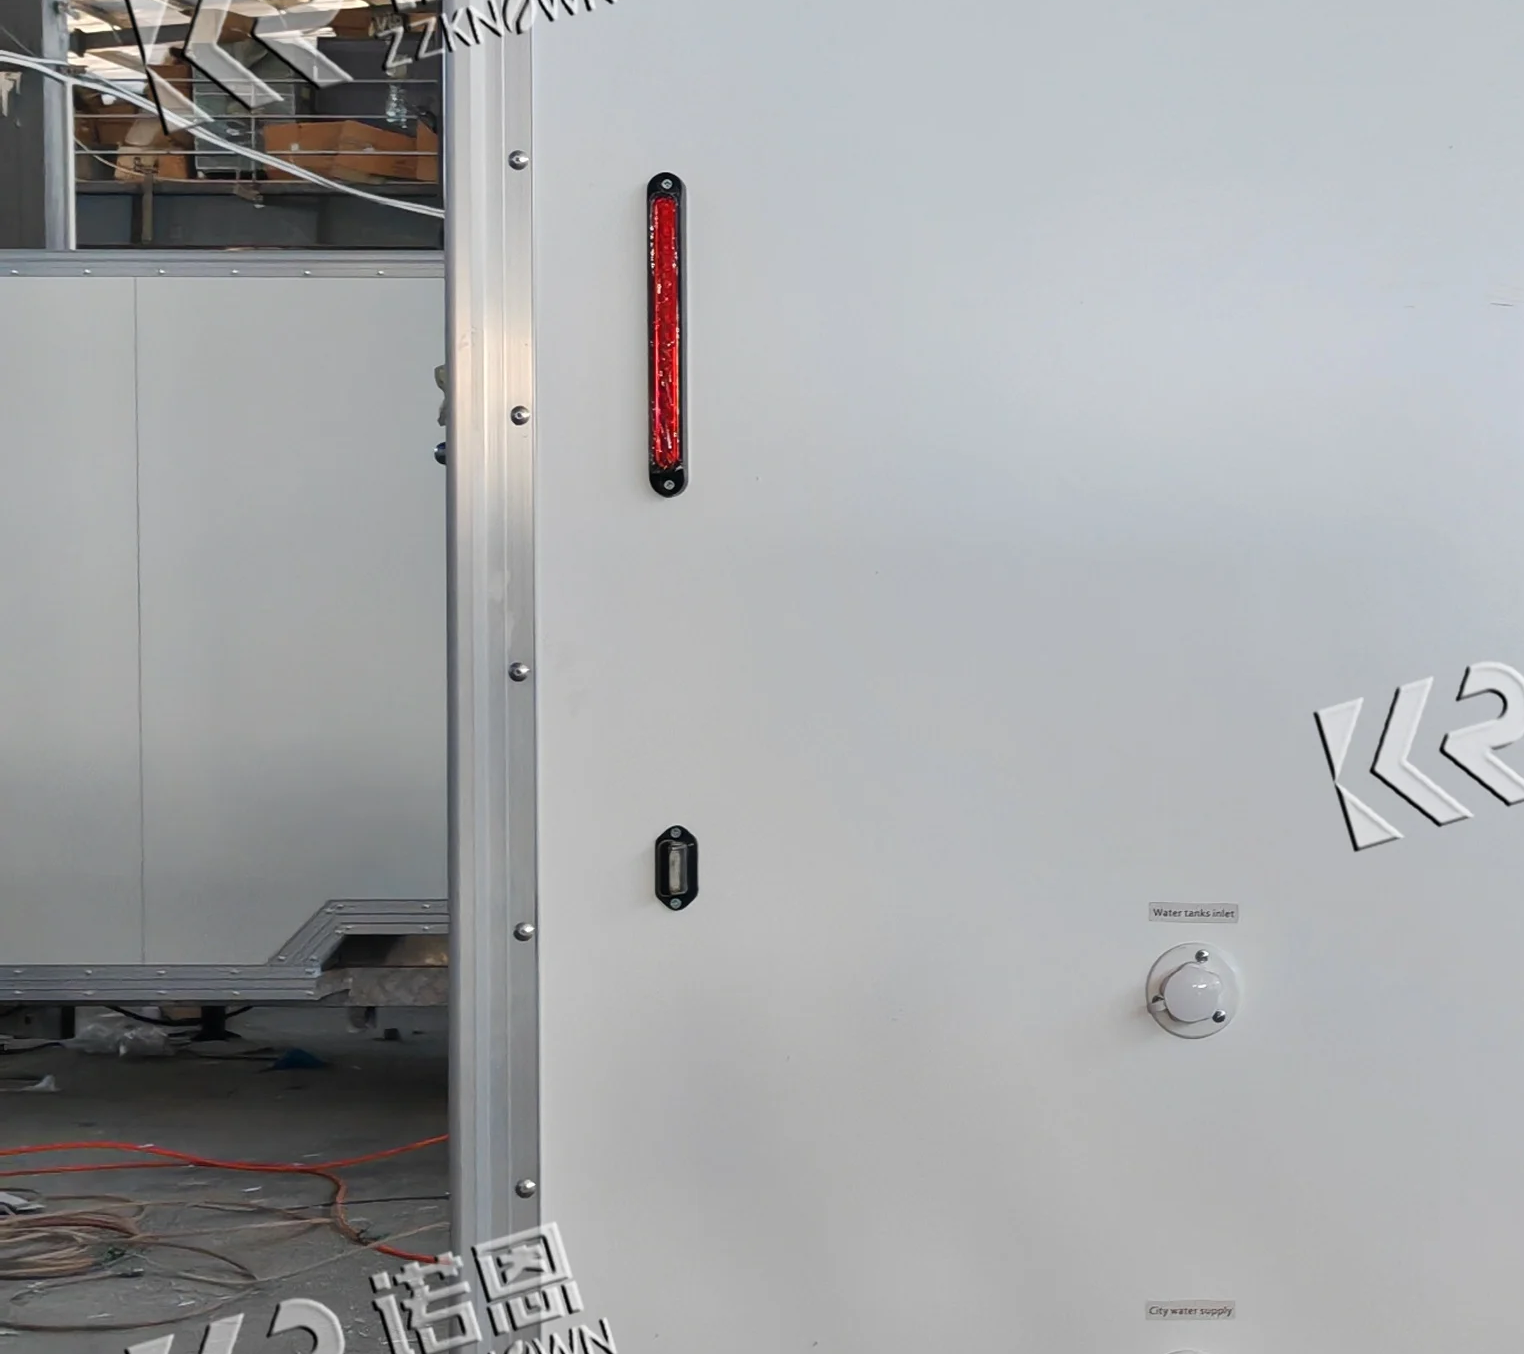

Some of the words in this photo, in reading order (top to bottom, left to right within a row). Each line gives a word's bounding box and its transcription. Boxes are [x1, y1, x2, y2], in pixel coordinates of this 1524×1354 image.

[1152, 907, 1182, 918] Water
[1184, 907, 1211, 918] tanks
[1212, 907, 1235, 918] inlet
[1148, 1305, 1169, 1318] City
[1170, 1307, 1198, 1316] water
[1200, 1305, 1233, 1318] supply
